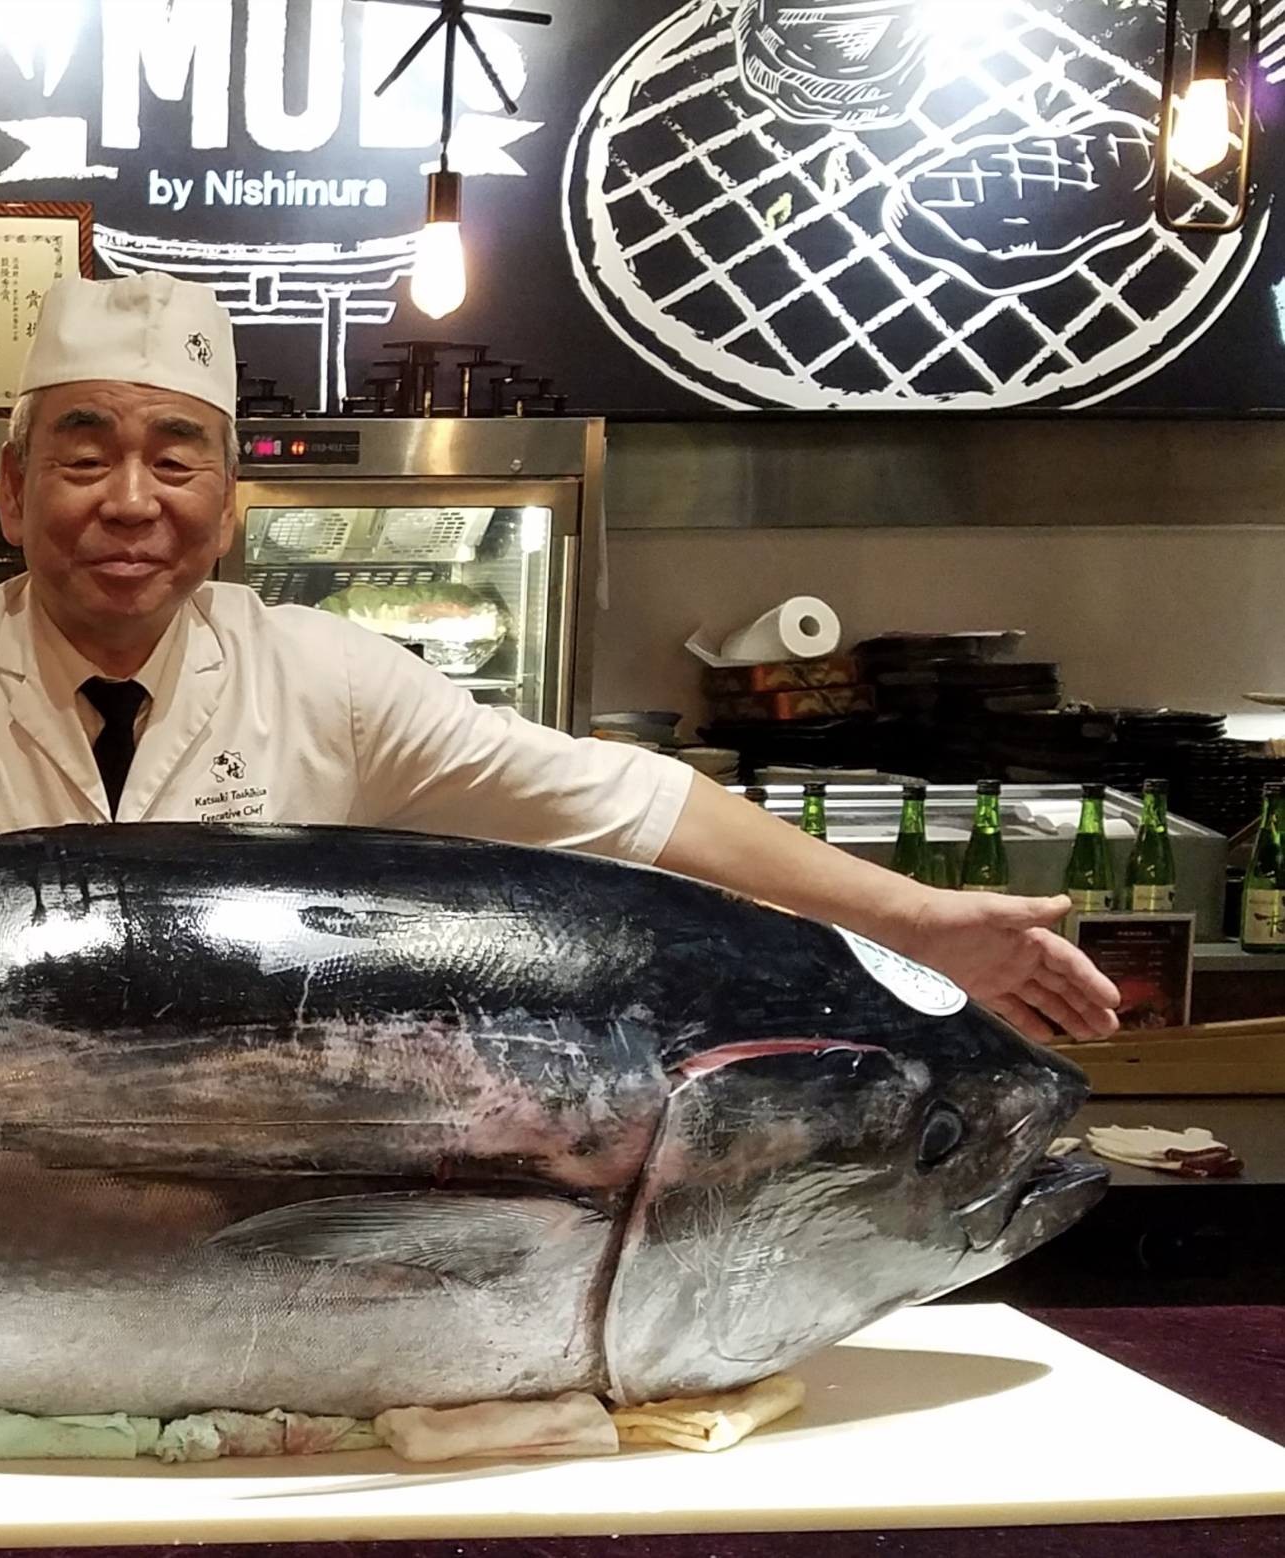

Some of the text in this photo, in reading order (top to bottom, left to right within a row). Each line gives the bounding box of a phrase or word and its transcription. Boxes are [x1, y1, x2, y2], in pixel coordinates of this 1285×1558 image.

[149, 170, 387, 210] by Nishimura
[195, 792, 229, 807] Katsuki
[243, 803, 264, 816] Chef
